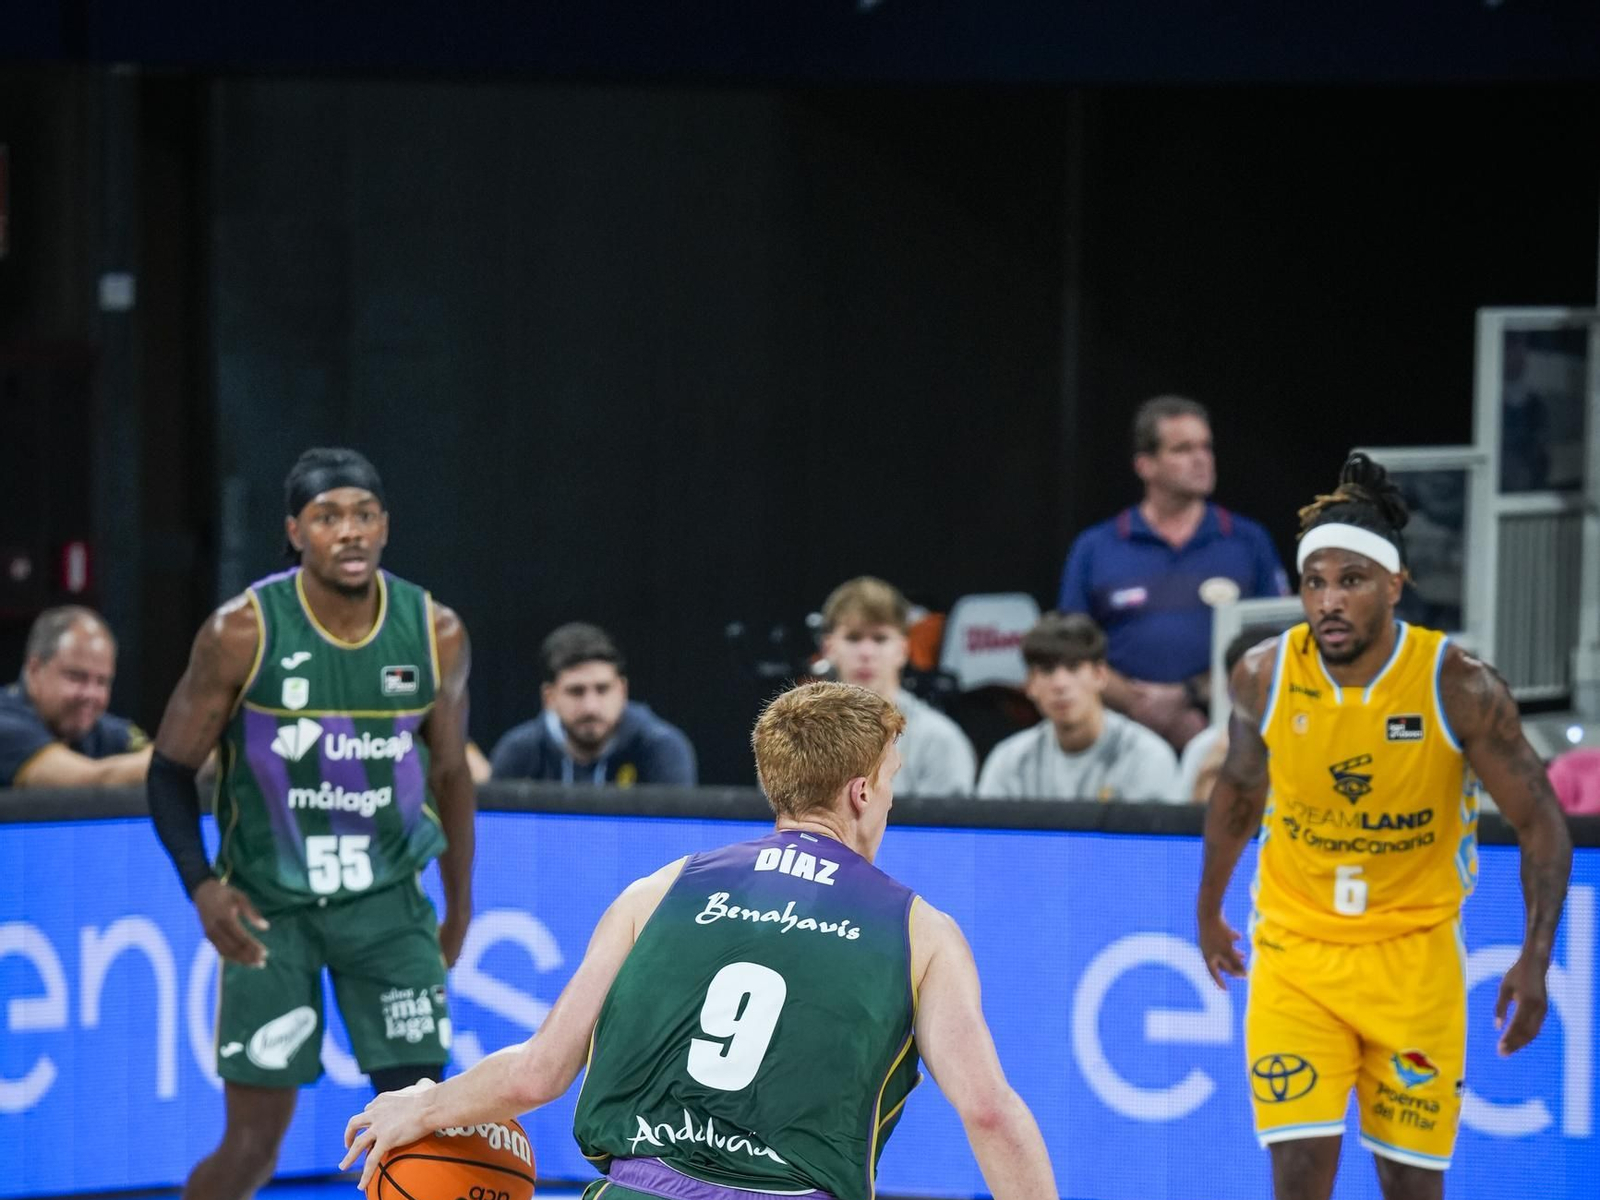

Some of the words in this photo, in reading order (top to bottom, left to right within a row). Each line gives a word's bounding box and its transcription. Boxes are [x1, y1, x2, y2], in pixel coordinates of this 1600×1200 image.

[305, 834, 374, 895] 55
[754, 843, 840, 886] DÍAZ
[1333, 864, 1369, 916] 6
[686, 961, 787, 1092] 9
